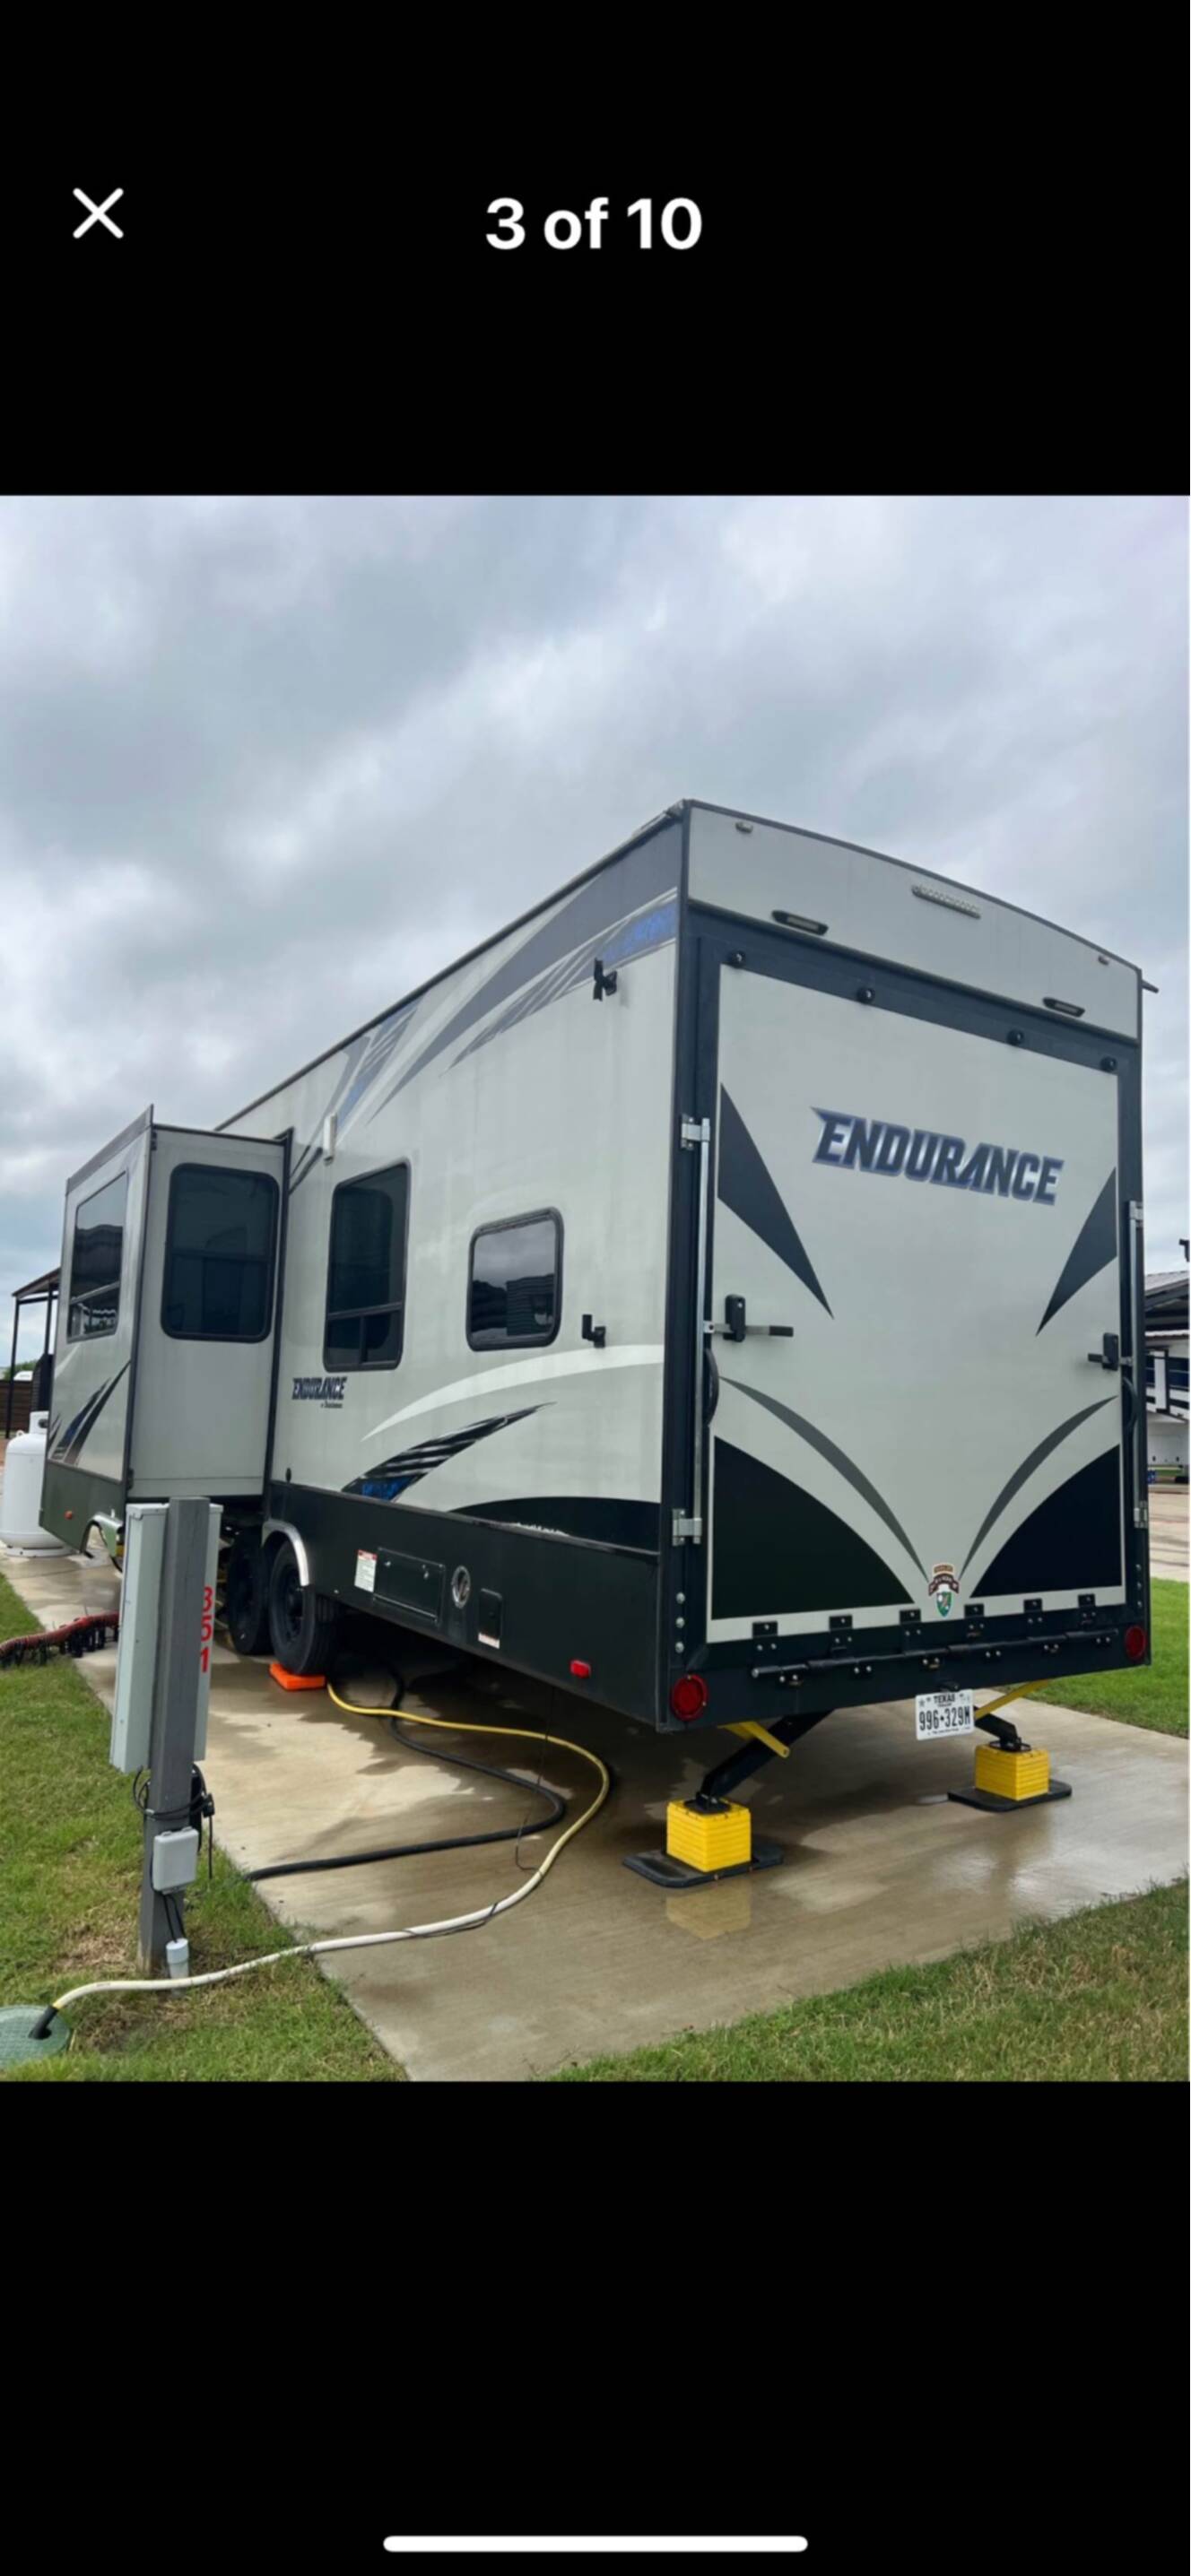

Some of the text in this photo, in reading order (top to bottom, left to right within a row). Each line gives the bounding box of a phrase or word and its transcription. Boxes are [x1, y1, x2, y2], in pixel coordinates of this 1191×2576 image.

[810, 1106, 1065, 1206] ENDURANCE
[291, 1376, 347, 1401] ENDURANCE
[933, 1693, 955, 1704] TEXAS
